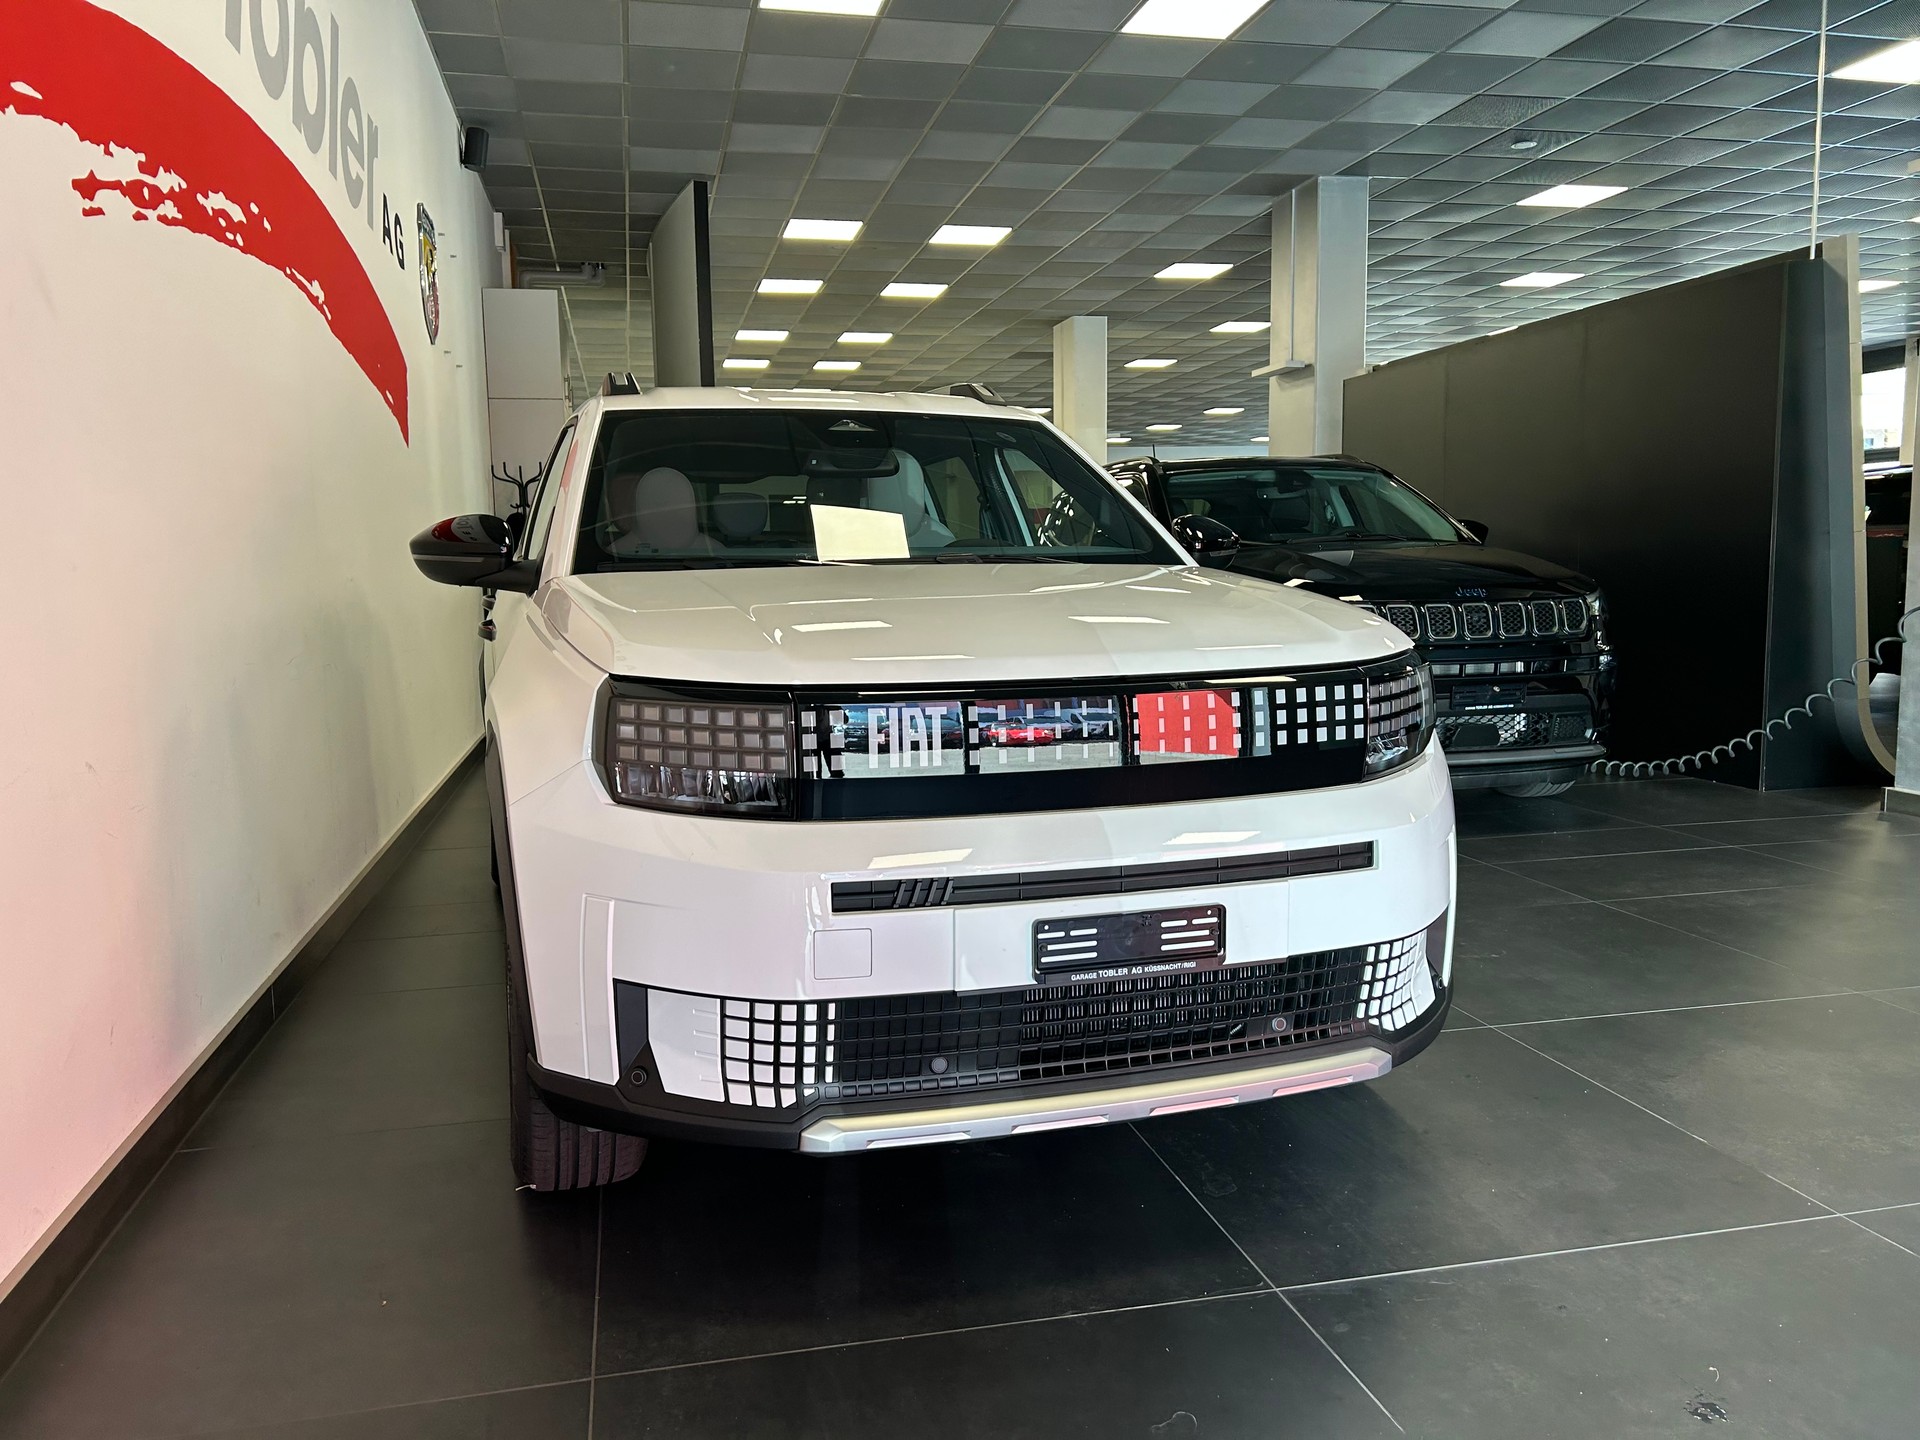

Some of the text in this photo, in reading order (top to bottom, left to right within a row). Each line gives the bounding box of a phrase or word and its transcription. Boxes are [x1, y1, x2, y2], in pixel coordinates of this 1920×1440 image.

[225, 0, 405, 270] obler AG
[1455, 586, 1488, 598] Jeep
[867, 706, 948, 769] FIAT
[1071, 973, 1098, 981] GARAGE
[1098, 968, 1129, 978] TOBLER
[1131, 966, 1143, 975] AG
